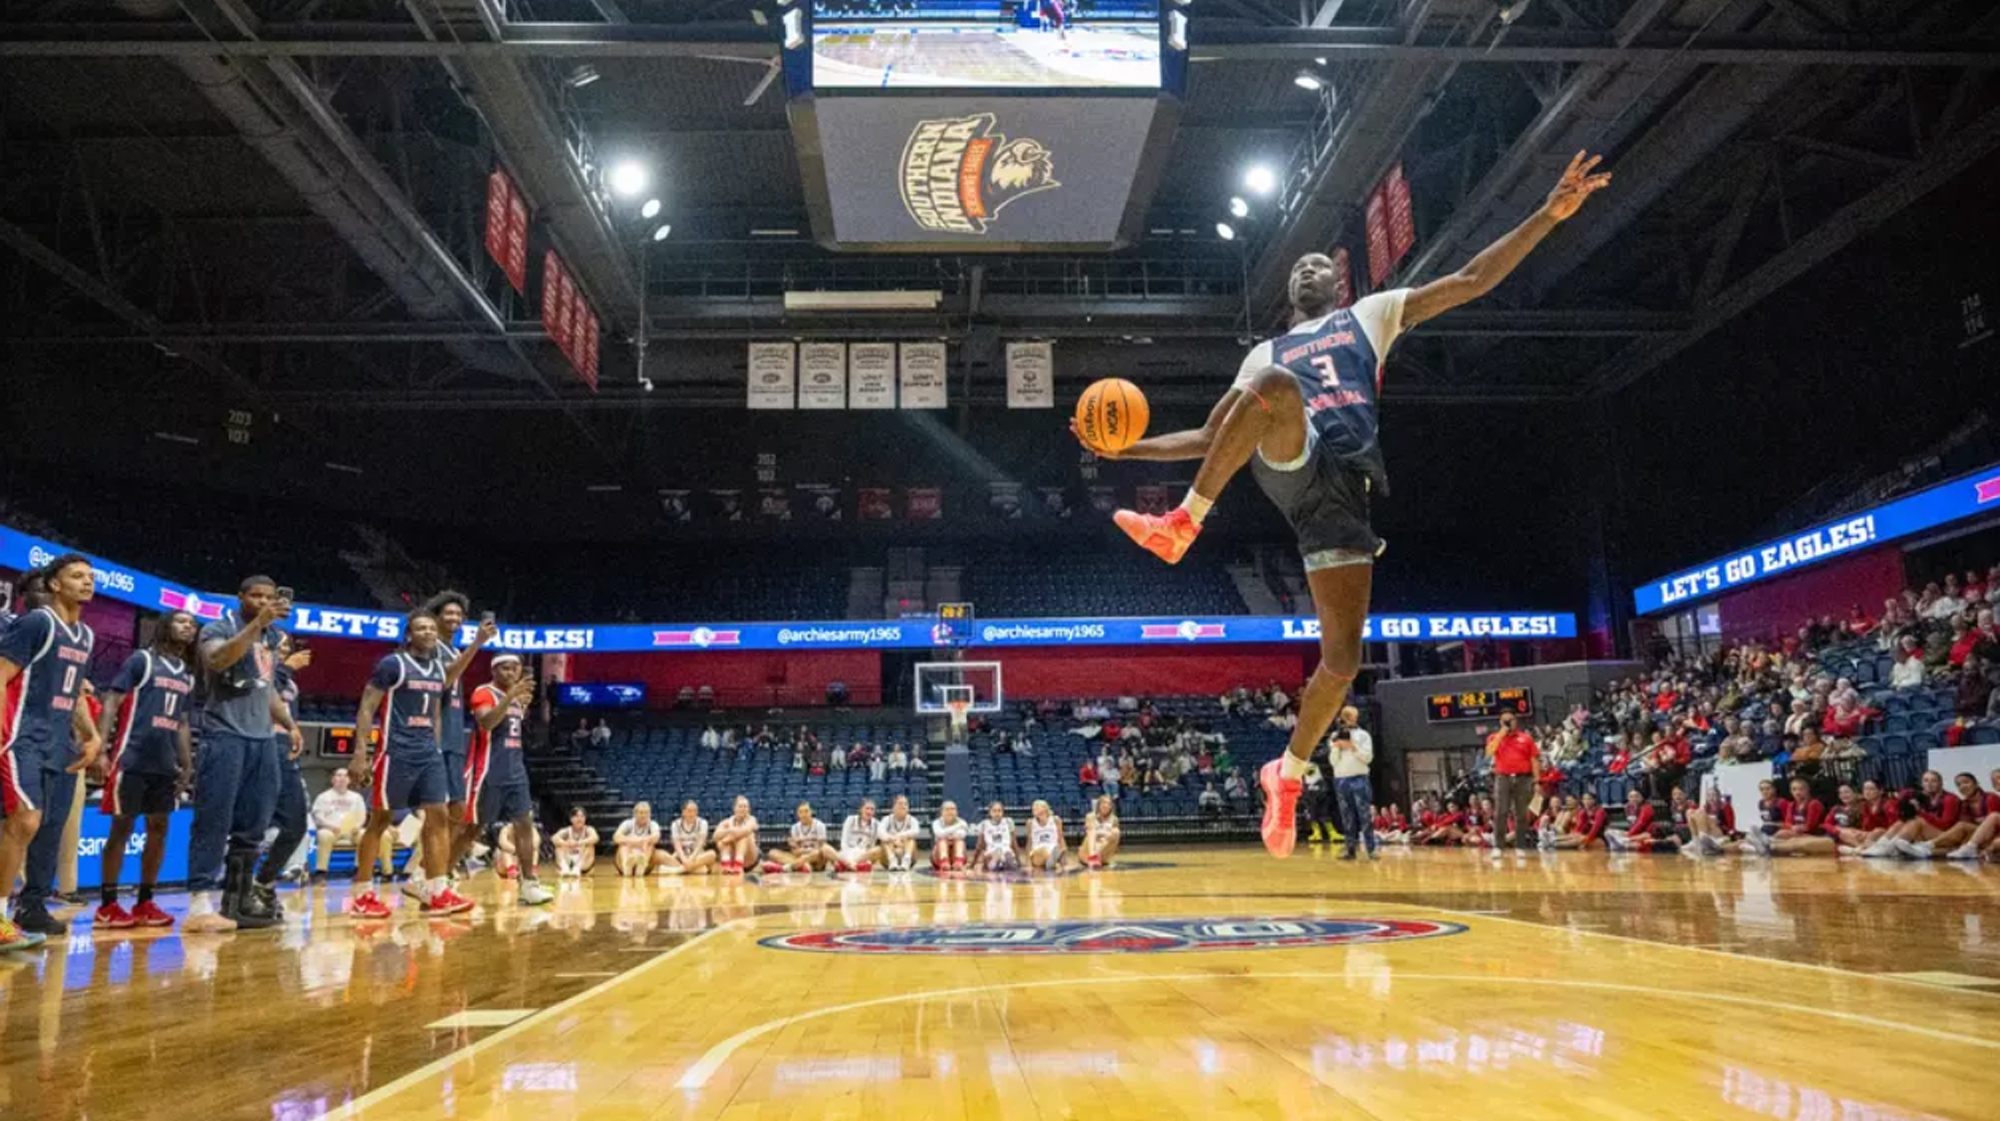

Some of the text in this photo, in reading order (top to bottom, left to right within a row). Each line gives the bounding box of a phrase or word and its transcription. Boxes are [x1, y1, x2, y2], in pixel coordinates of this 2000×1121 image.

[905, 122, 947, 228] SOUTHERN
[929, 118, 982, 230] INDIANA
[1310, 354, 1340, 388] 3
[228, 409, 252, 426] 203
[1106, 400, 1118, 436] NCAA
[228, 428, 250, 444] 103
[1660, 514, 1877, 604] LET'S GO EAGLES!
[295, 607, 400, 639] LET'S
[983, 623, 1105, 642] @archiesarmy1965
[1381, 618, 1420, 638] GO
[1429, 616, 1558, 638] EAGLES!
[777, 627, 901, 645] @archiesarmy1965
[62, 665, 77, 693] 0
[1440, 705, 1449, 718] 0
[337, 739, 348, 752] 0
